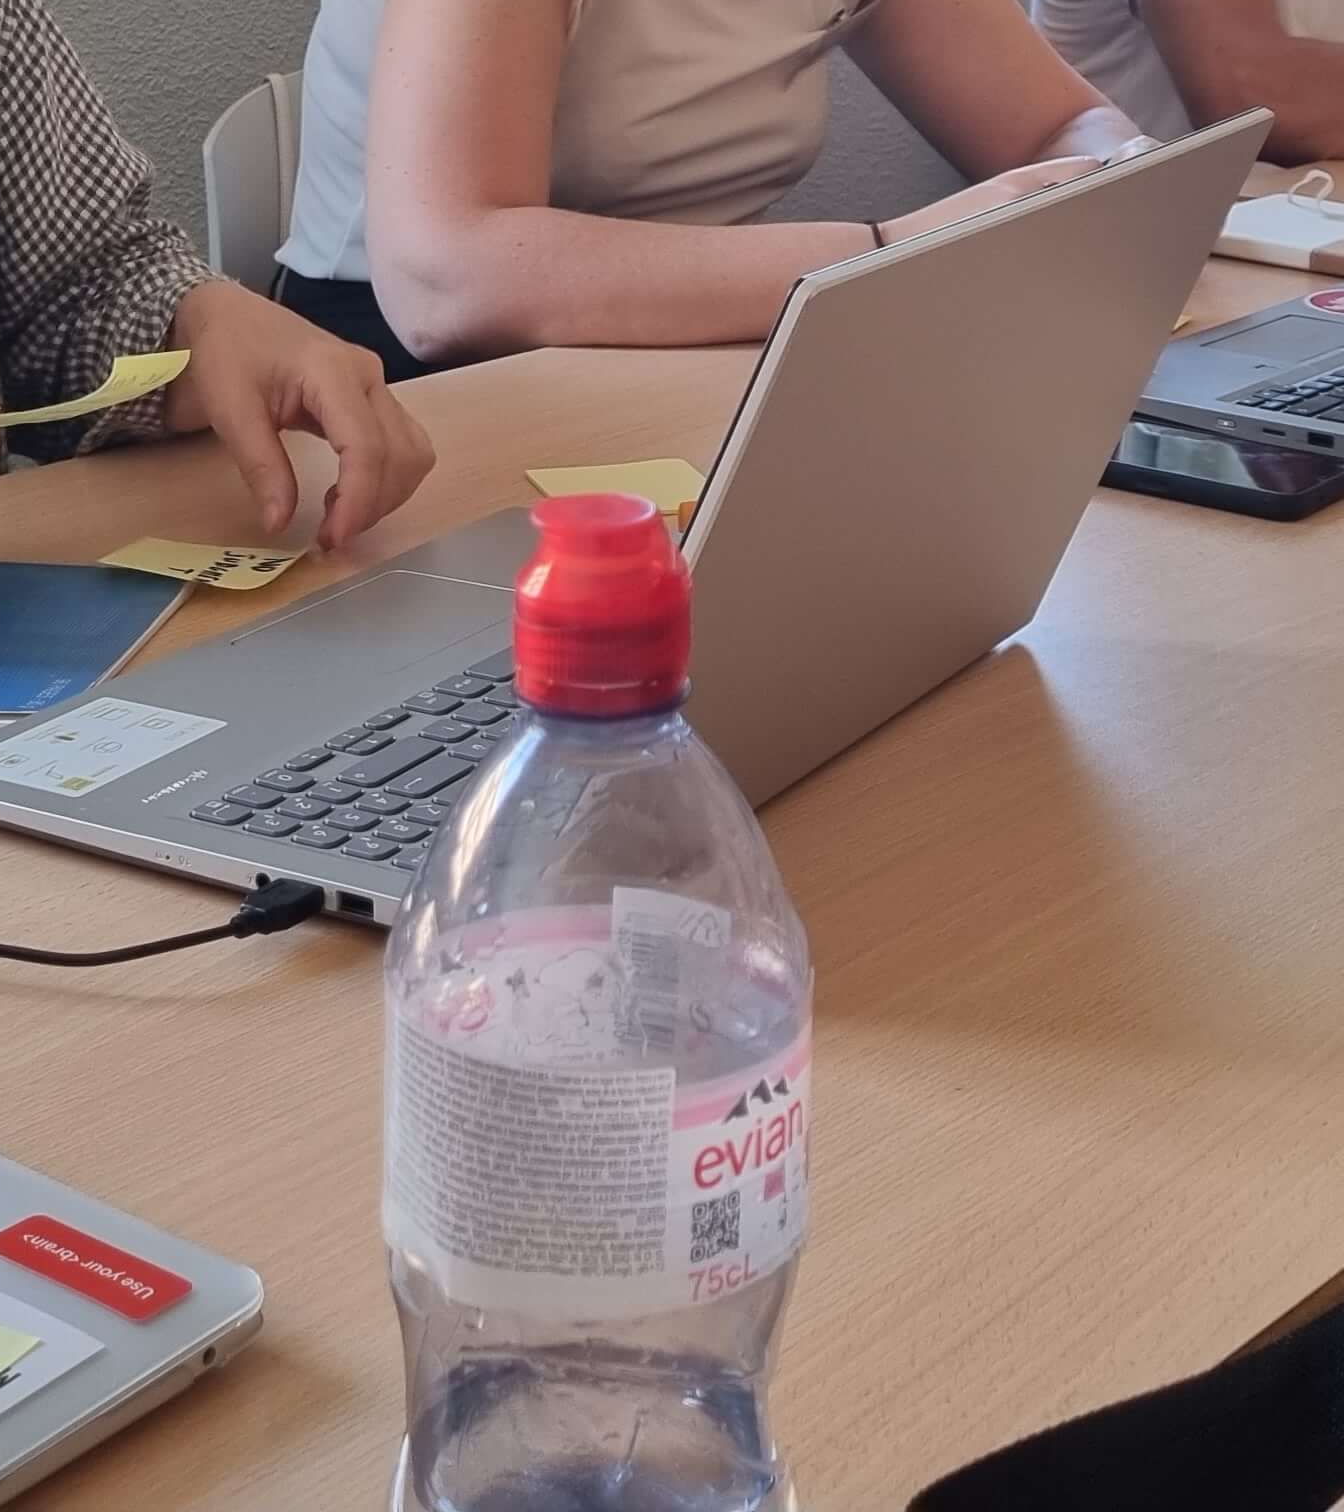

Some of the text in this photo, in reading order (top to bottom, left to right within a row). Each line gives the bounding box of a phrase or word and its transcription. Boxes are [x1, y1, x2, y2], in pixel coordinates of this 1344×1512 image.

[693, 1100, 803, 1190] evian
[80, 1259, 126, 1280] your
[120, 1276, 155, 1300] Use
